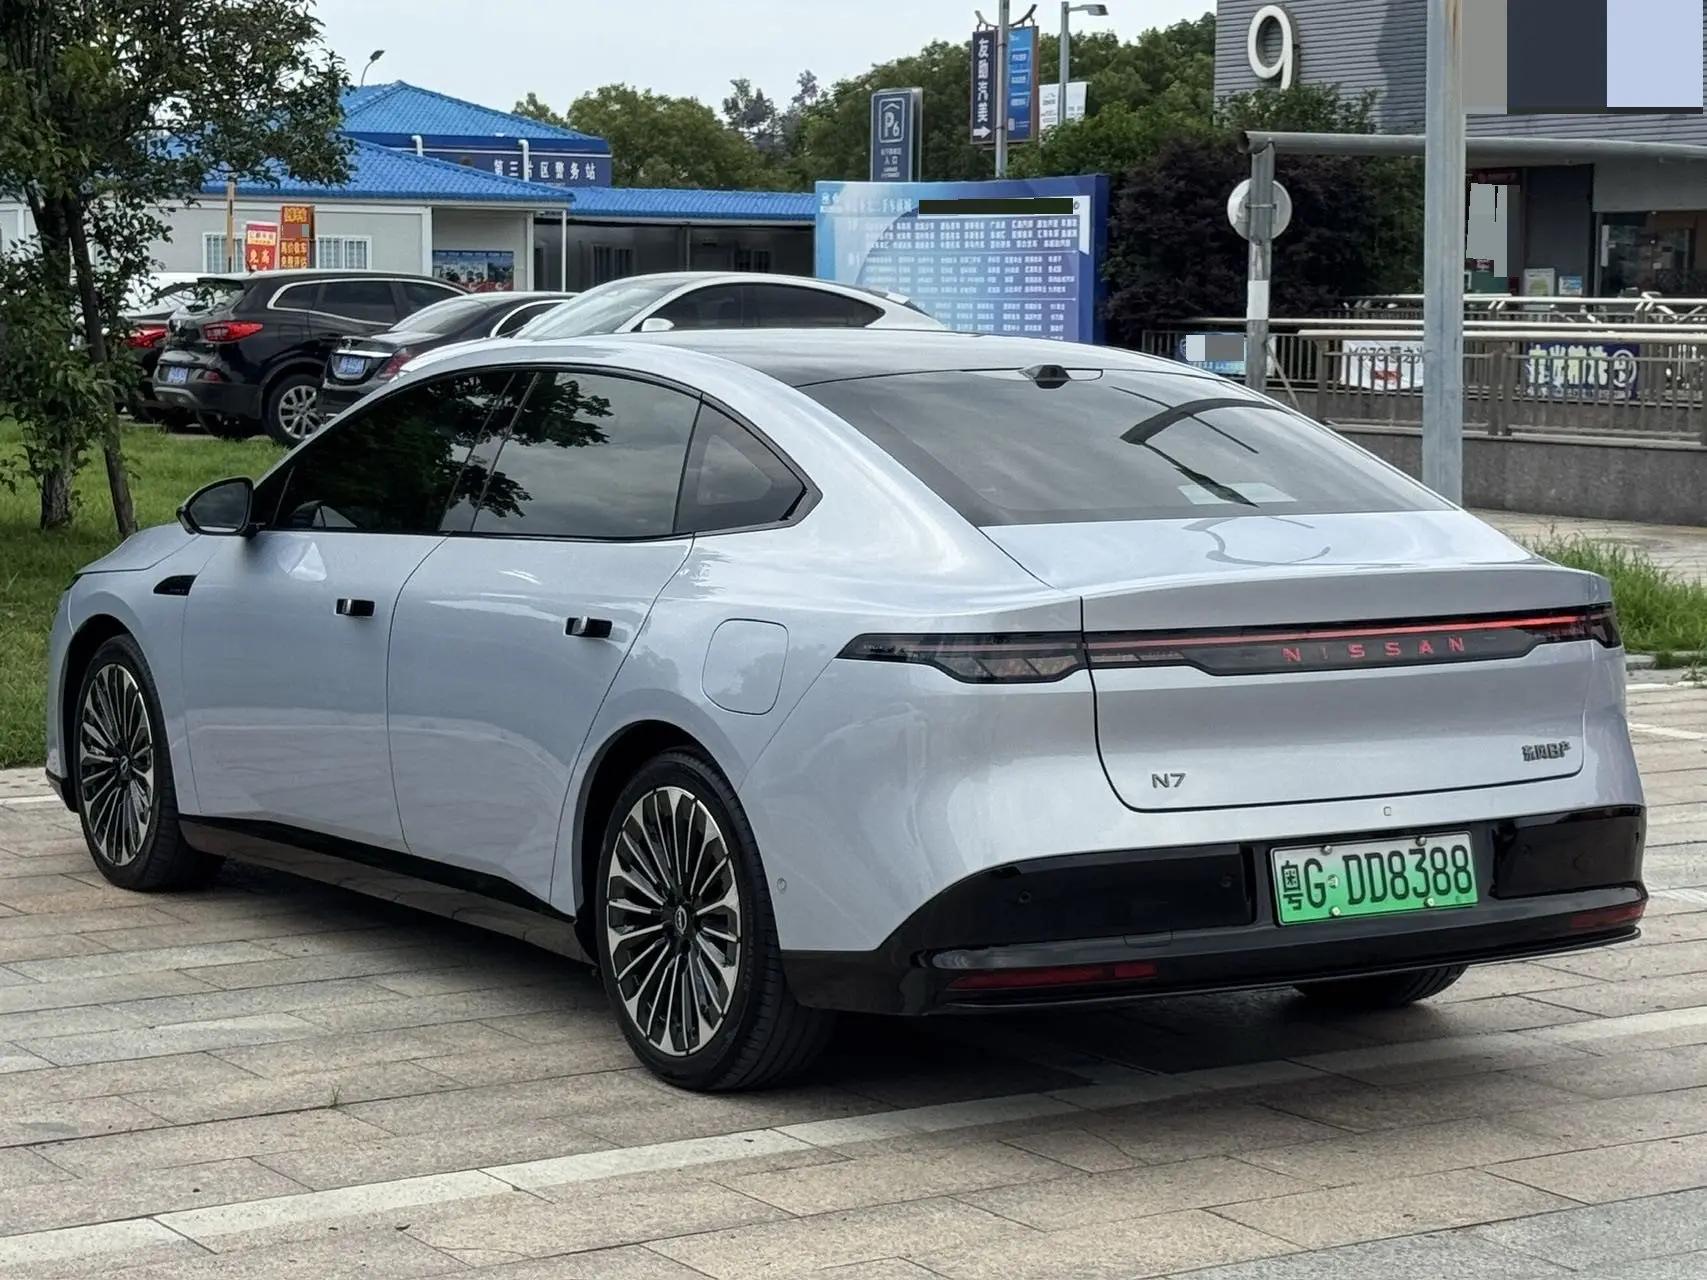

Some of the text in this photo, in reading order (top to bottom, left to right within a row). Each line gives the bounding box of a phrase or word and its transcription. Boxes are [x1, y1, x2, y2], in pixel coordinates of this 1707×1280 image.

[1247, 4, 1294, 91] 9
[1281, 637, 1465, 662] NISSAN
[1151, 772, 1187, 789] N7
